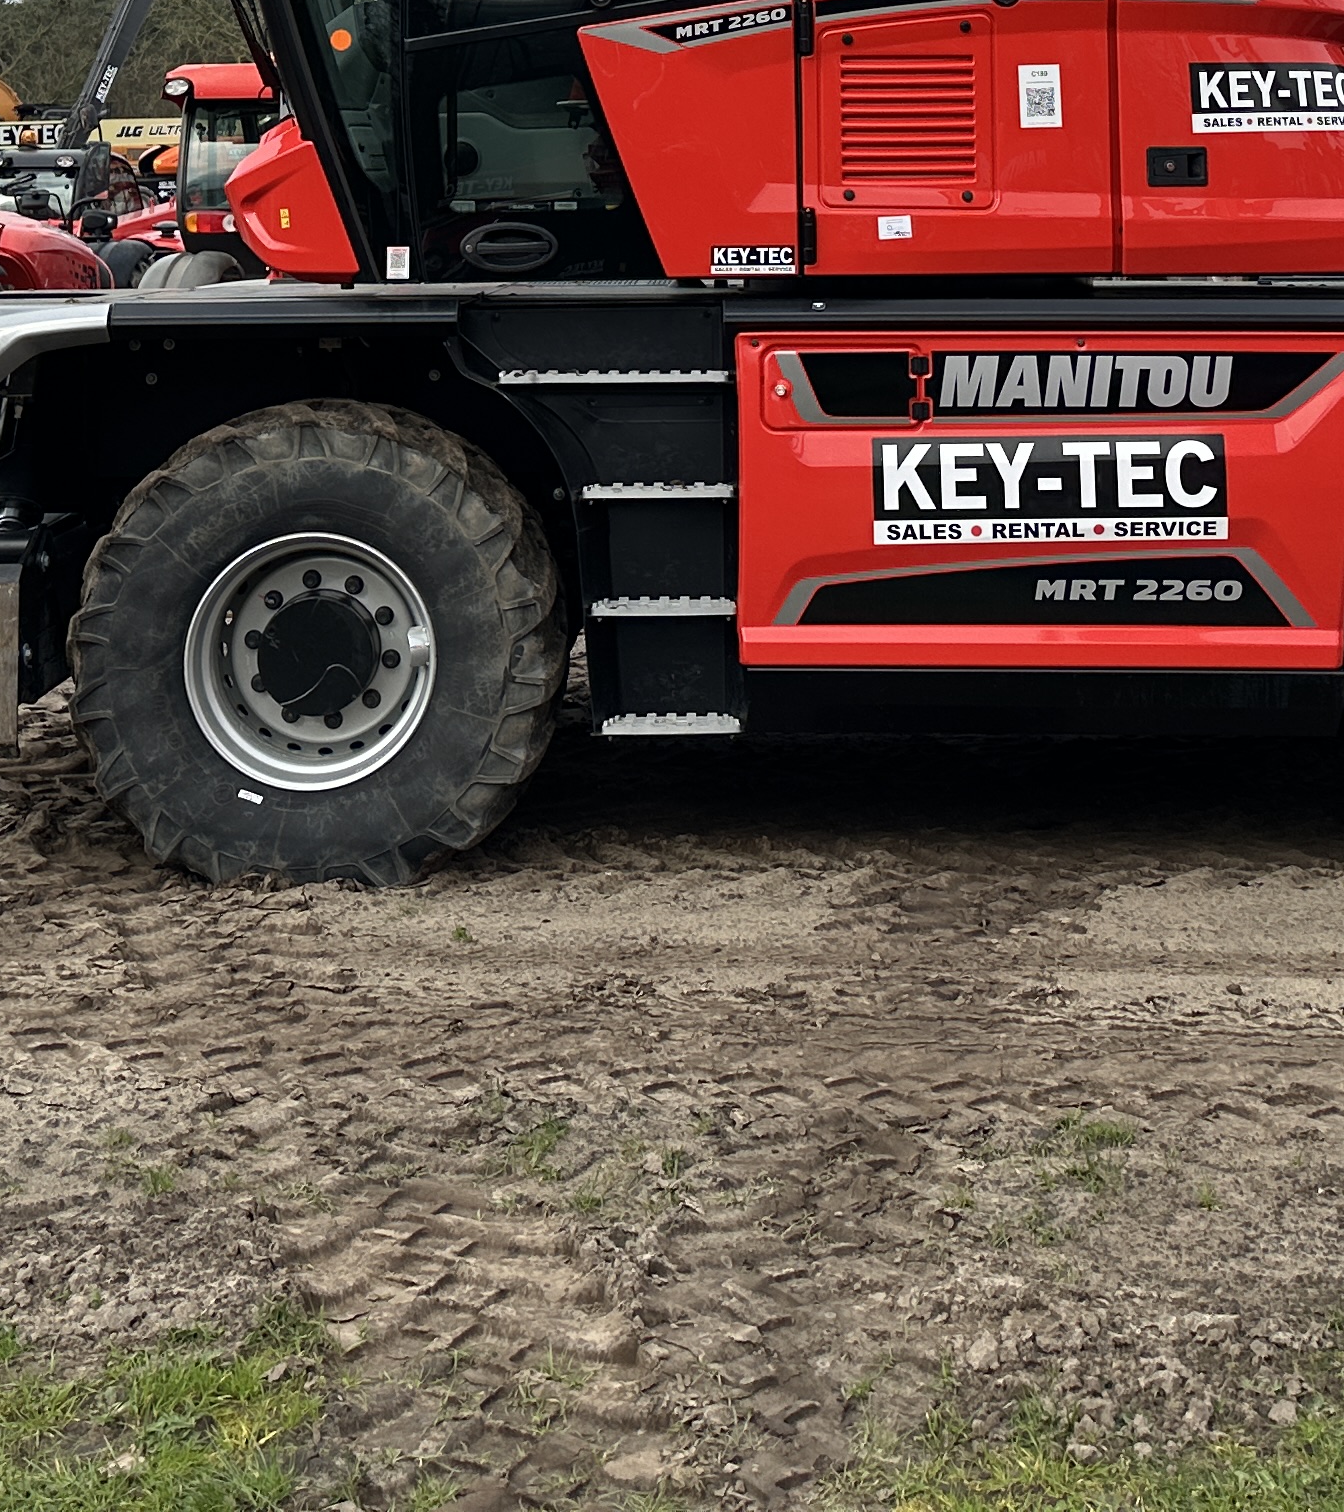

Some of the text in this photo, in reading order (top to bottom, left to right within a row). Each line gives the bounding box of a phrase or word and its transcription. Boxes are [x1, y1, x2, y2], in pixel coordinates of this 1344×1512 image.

[676, 8, 787, 39] MRT 2260
[95, 64, 115, 101] KEY-TEC
[116, 125, 144, 137] JLG
[1203, 118, 1243, 128] SALES
[1257, 116, 1303, 127] RENTAL
[713, 247, 794, 264] KEY-TEC
[939, 355, 1233, 408] MANITOU
[881, 439, 1218, 512] KEY-TEC
[886, 520, 1218, 541] SALES RENTAL SERVICE
[1034, 578, 1244, 602] MRT 2260
